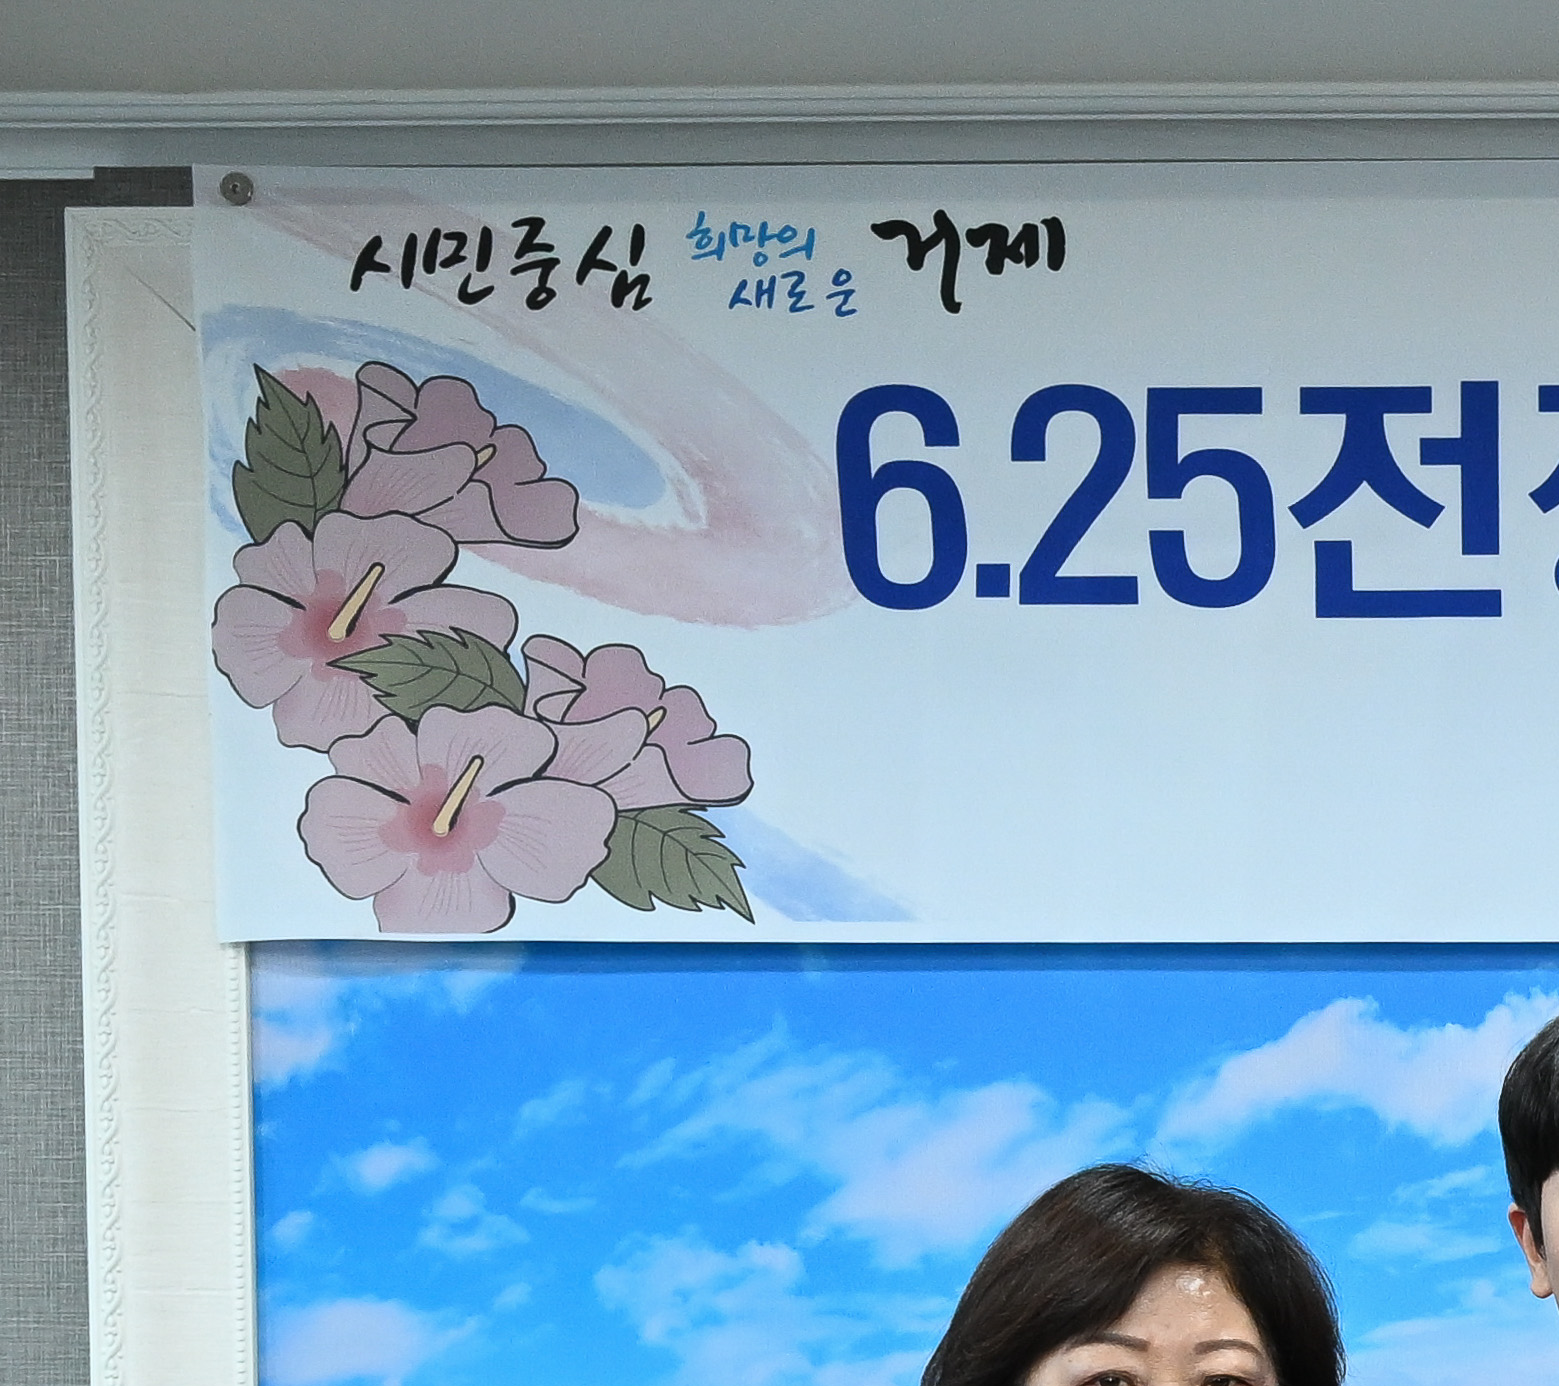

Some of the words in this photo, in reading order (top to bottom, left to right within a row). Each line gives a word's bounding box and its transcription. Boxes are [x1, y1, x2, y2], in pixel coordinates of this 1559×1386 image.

[350, 217, 652, 311] 시민중심
[686, 211, 816, 272] 희망의
[871, 209, 1065, 314] 거제
[729, 269, 857, 317] 새로운
